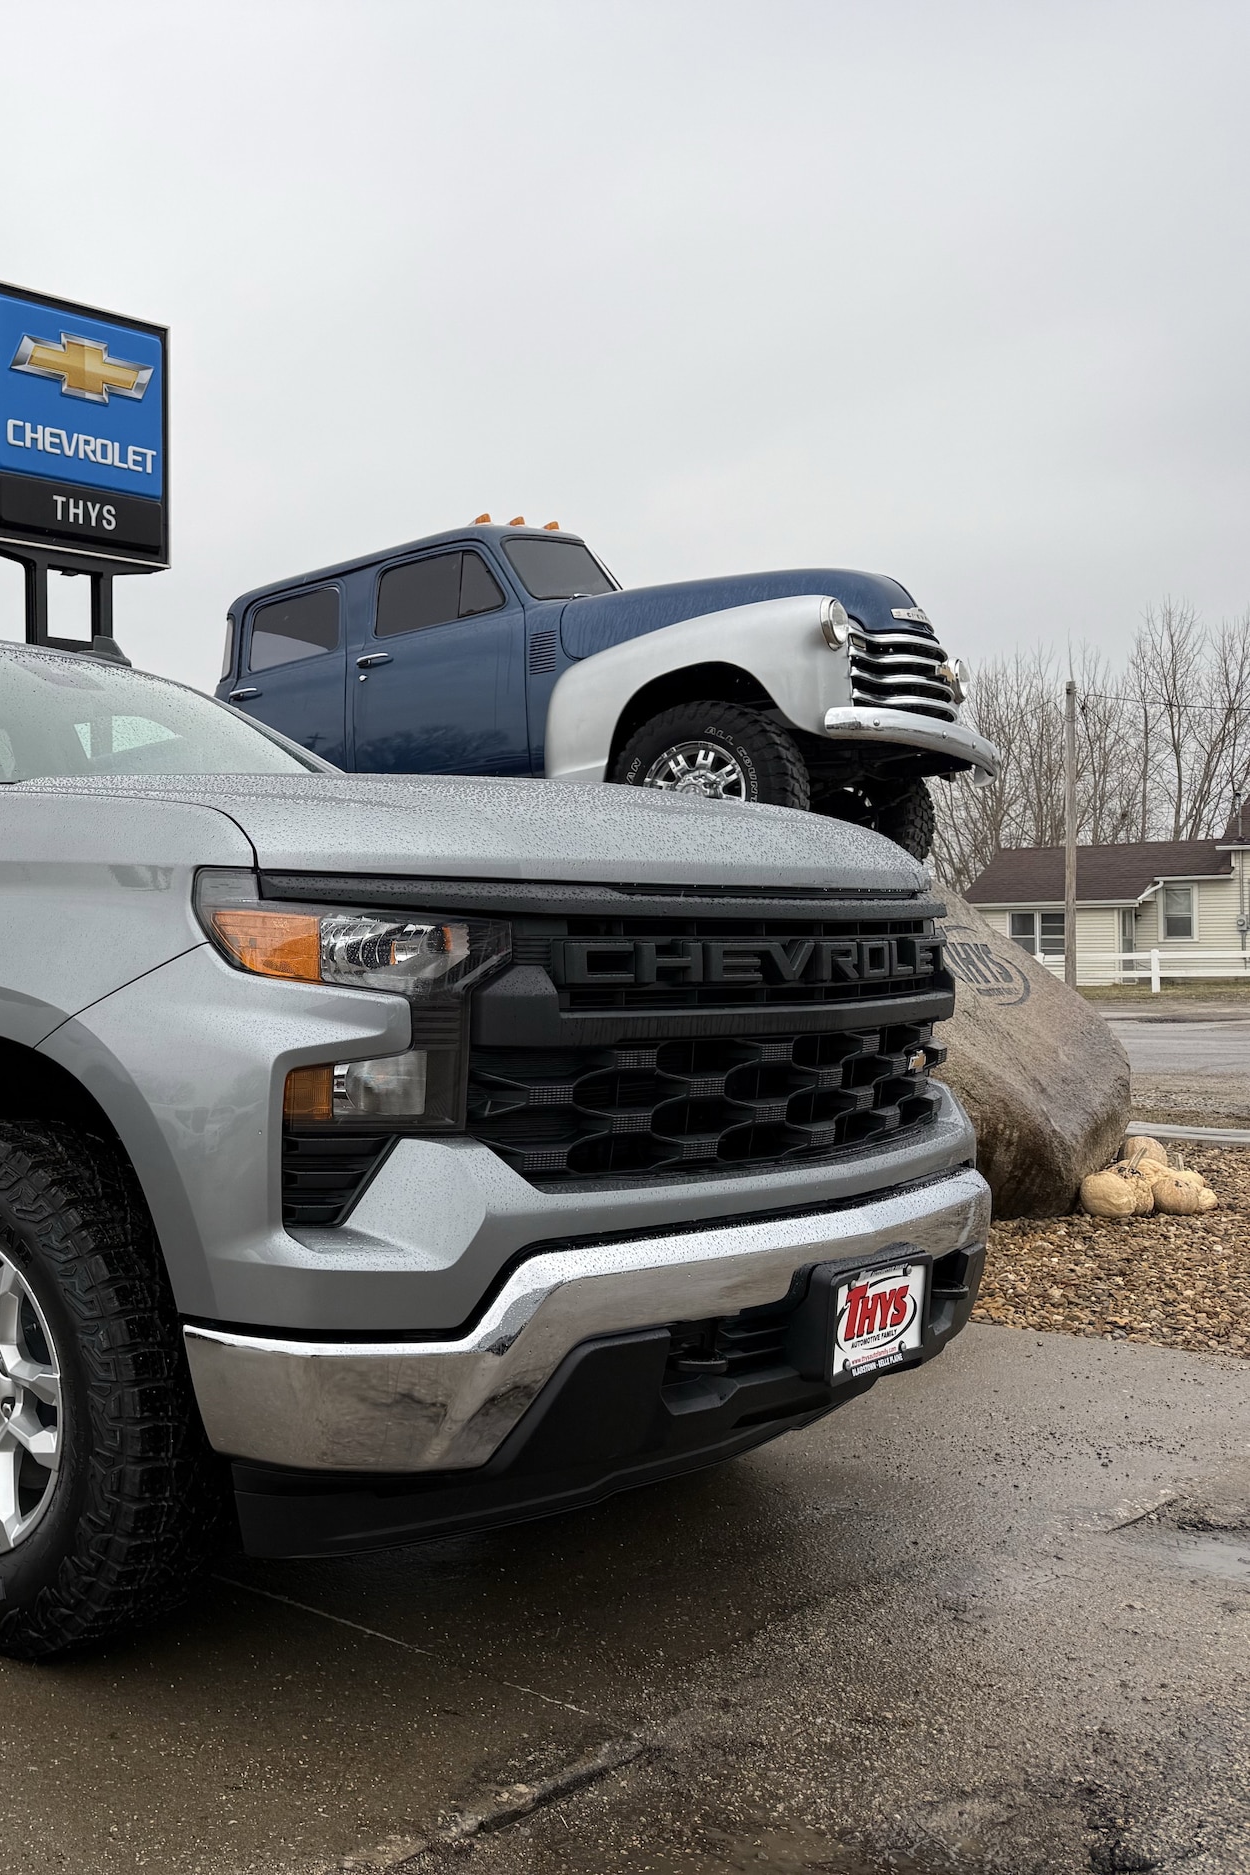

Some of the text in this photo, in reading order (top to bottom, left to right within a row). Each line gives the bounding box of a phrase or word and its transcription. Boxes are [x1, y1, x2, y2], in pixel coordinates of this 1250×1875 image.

[6, 418, 157, 474] CHEVROLET
[52, 494, 117, 531] THYS
[704, 726, 734, 746] ALL
[625, 757, 642, 785] AN
[561, 937, 948, 985] CHEVROLET
[844, 1281, 910, 1342] THYS
[851, 1328, 898, 1349] AUTOMOTIVE FAMILY
